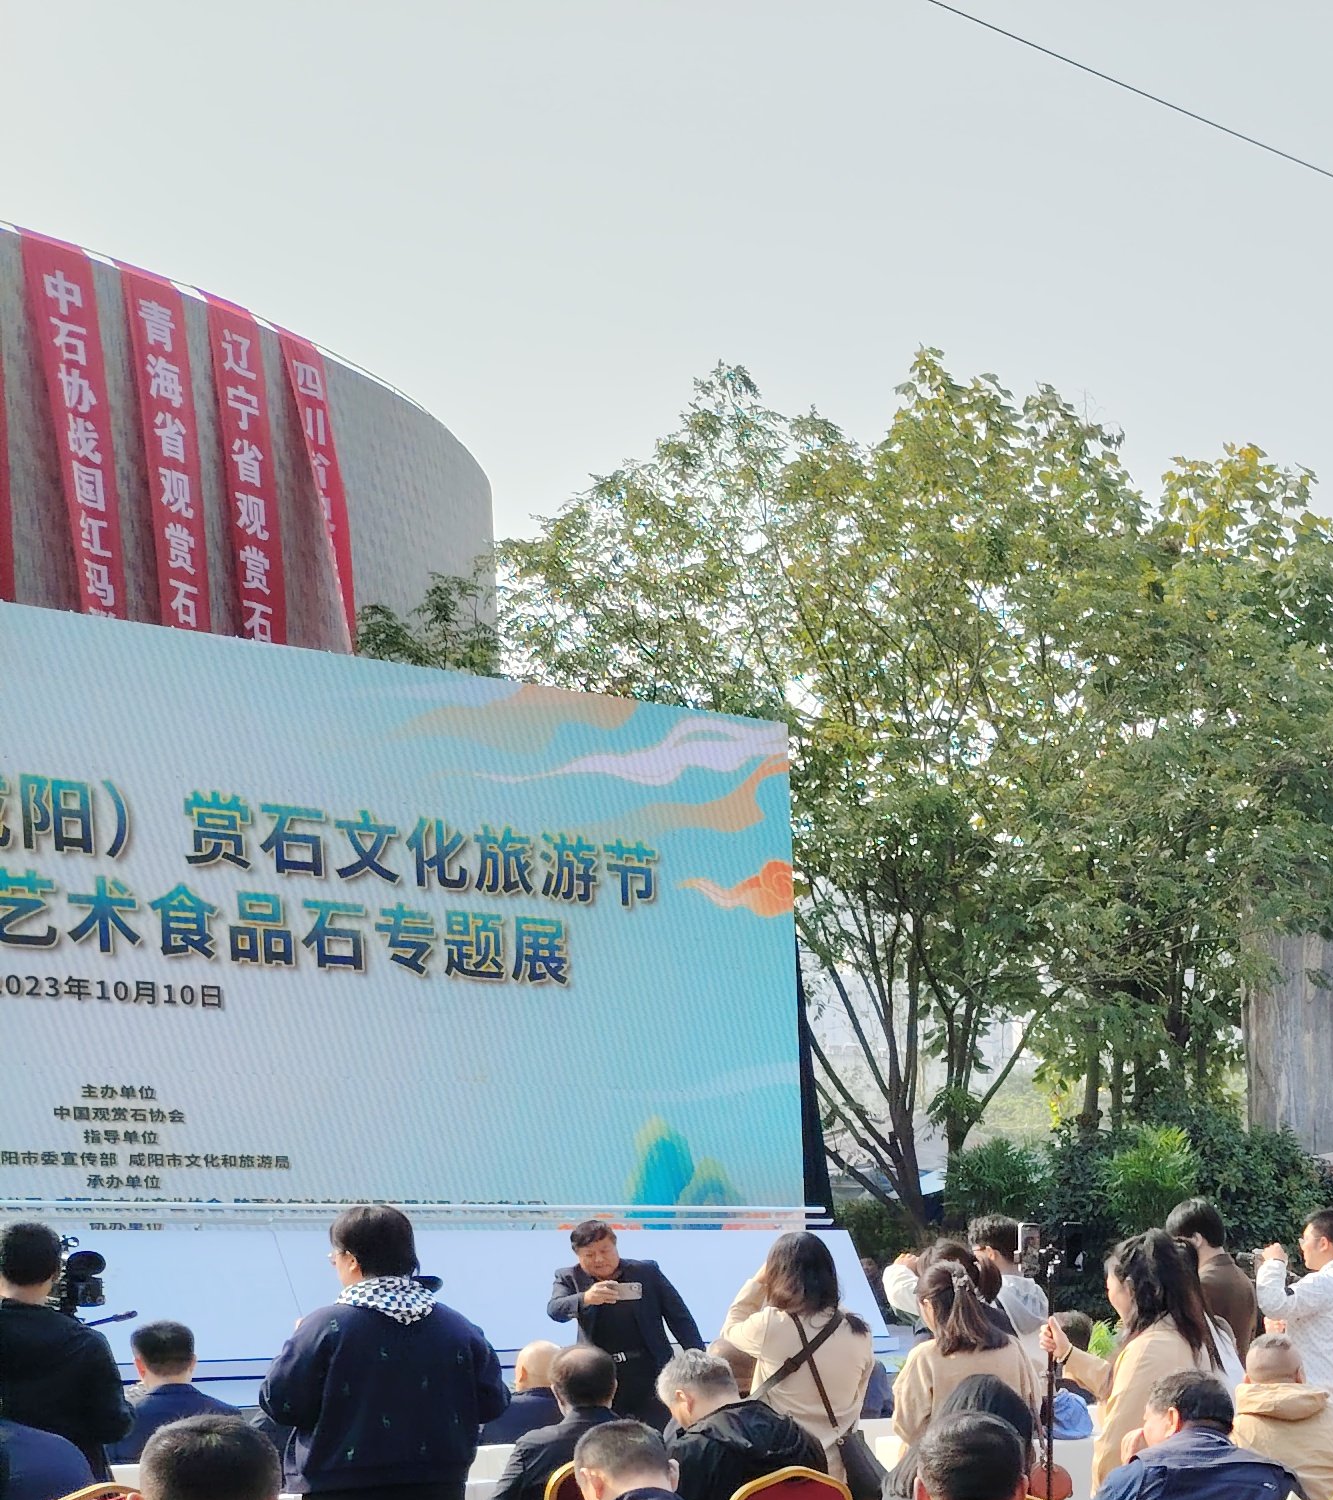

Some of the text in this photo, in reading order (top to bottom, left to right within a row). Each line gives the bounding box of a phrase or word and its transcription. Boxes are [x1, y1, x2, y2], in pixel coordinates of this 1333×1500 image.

[138, 299, 198, 628] 青海省观赏石
[221, 328, 273, 642] 辽宁省观赏石
[0, 866, 568, 985] 艺术食品石专题展
[0, 973, 223, 1008] 023年10月10日
[81, 1084, 157, 1100] 主办单位
[53, 1106, 186, 1123] 中国观赏石协会
[83, 1129, 159, 1145] 指导单位
[128, 1153, 291, 1169] 咸阳市文化和旅游局
[86, 1174, 161, 1189] 承办单位
